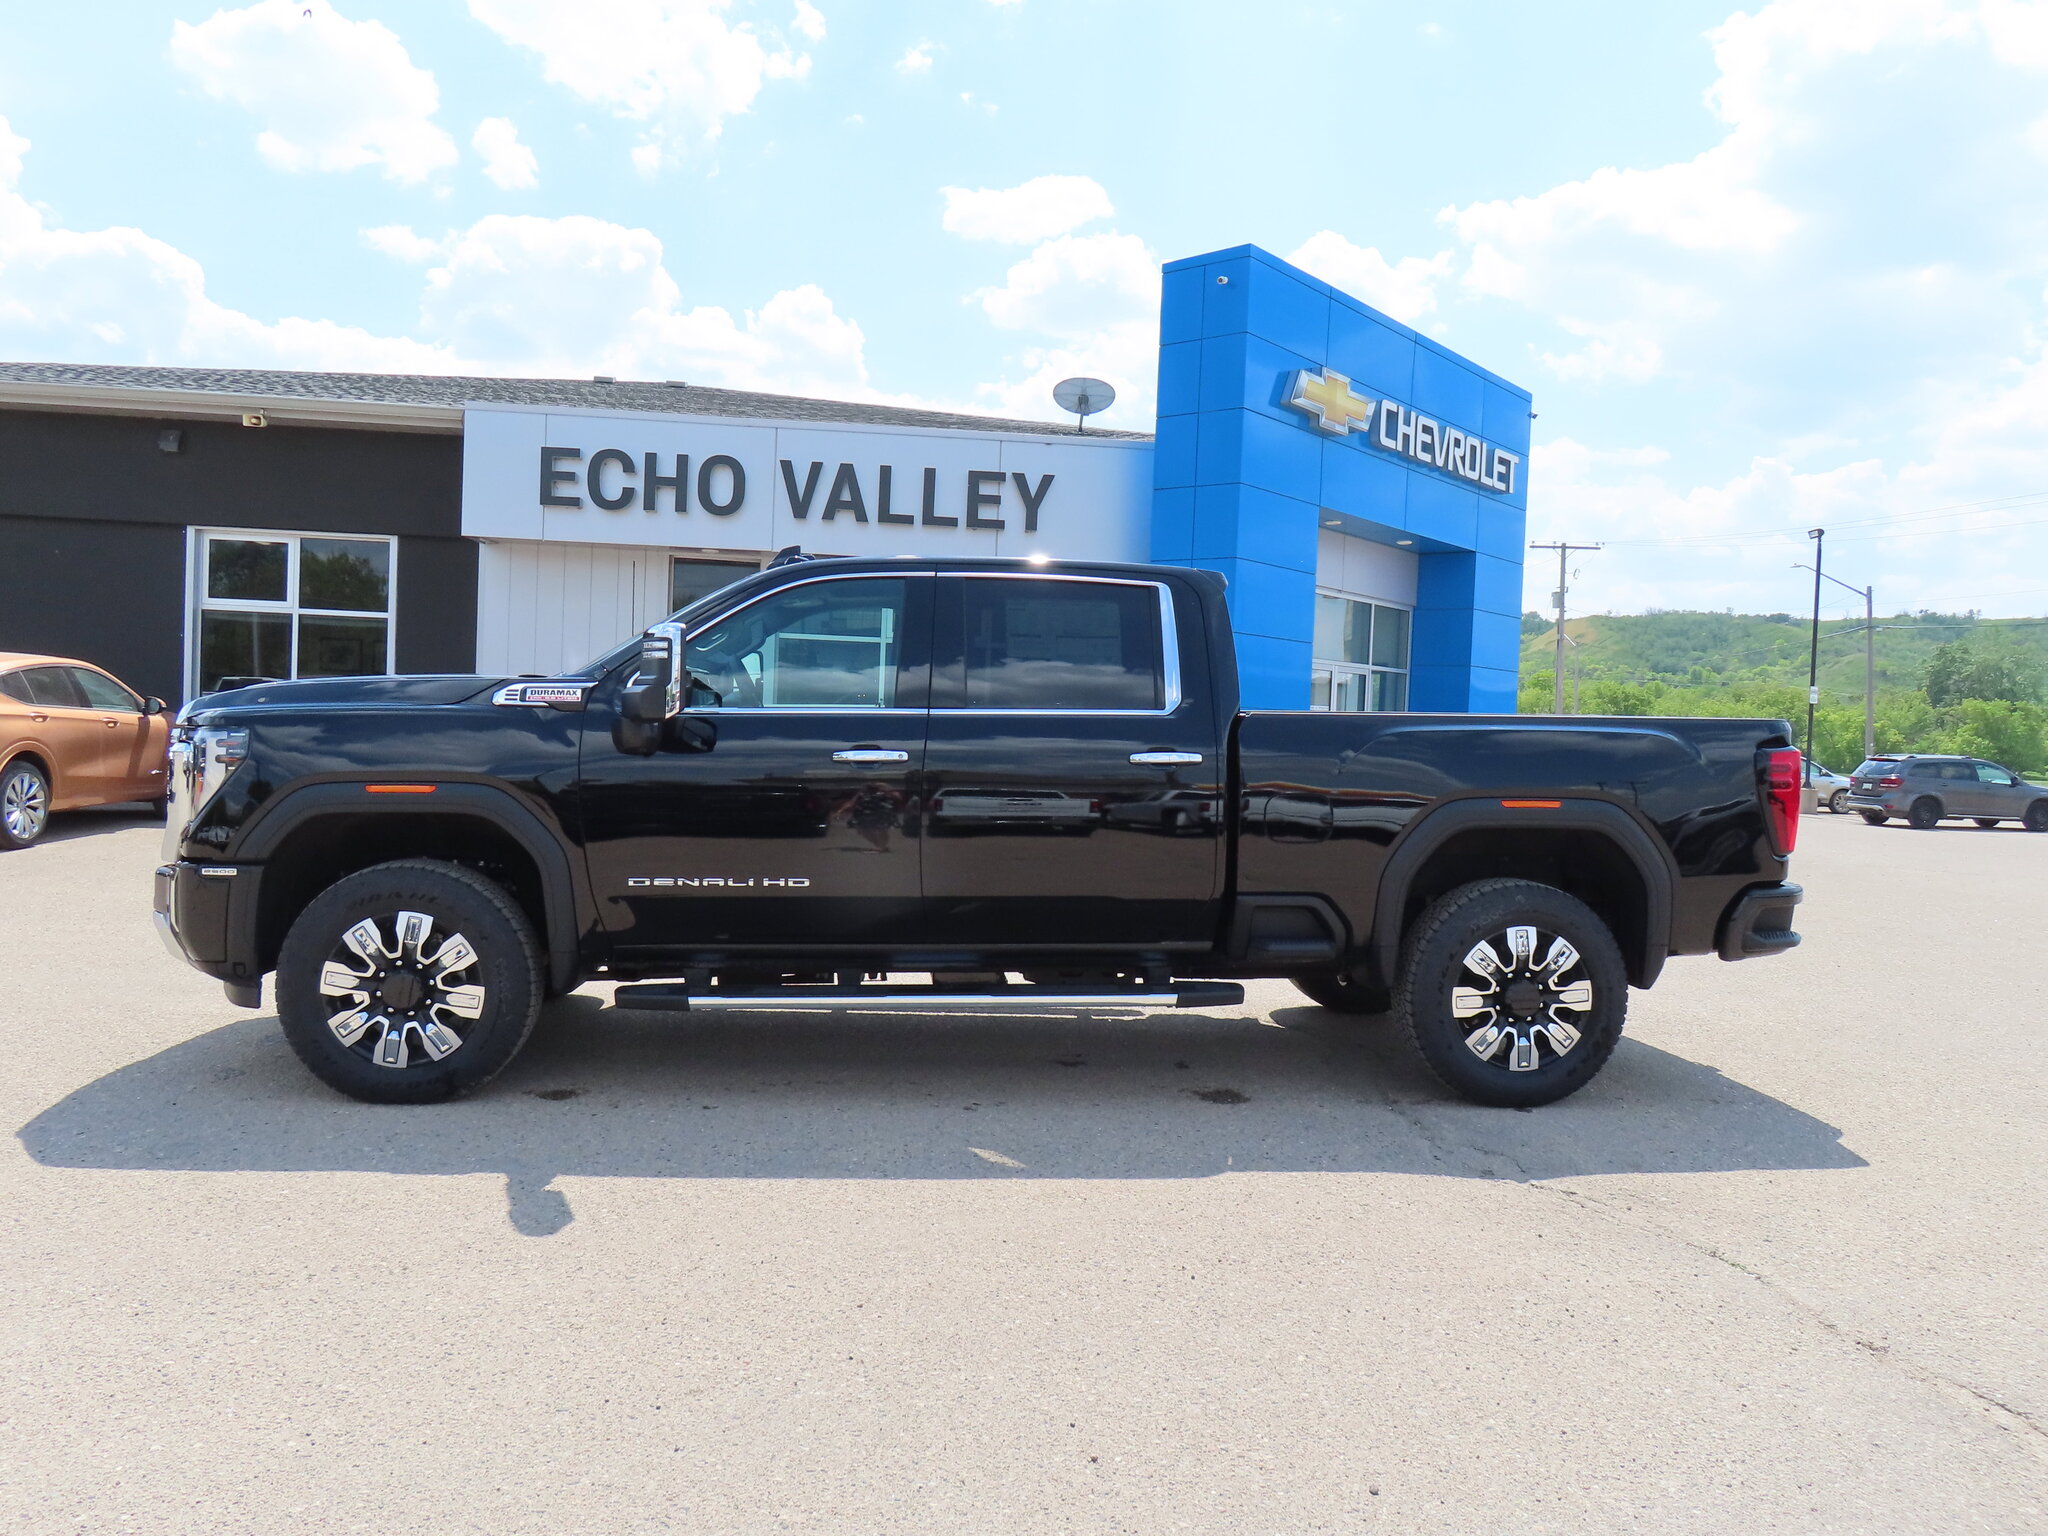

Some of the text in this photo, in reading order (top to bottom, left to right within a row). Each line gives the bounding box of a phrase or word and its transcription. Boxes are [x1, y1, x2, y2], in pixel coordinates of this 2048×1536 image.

[540, 446, 1055, 532] ECHO VALLEY
[1380, 399, 1520, 494] CHEVROLET
[627, 877, 811, 887] DENALI HD
